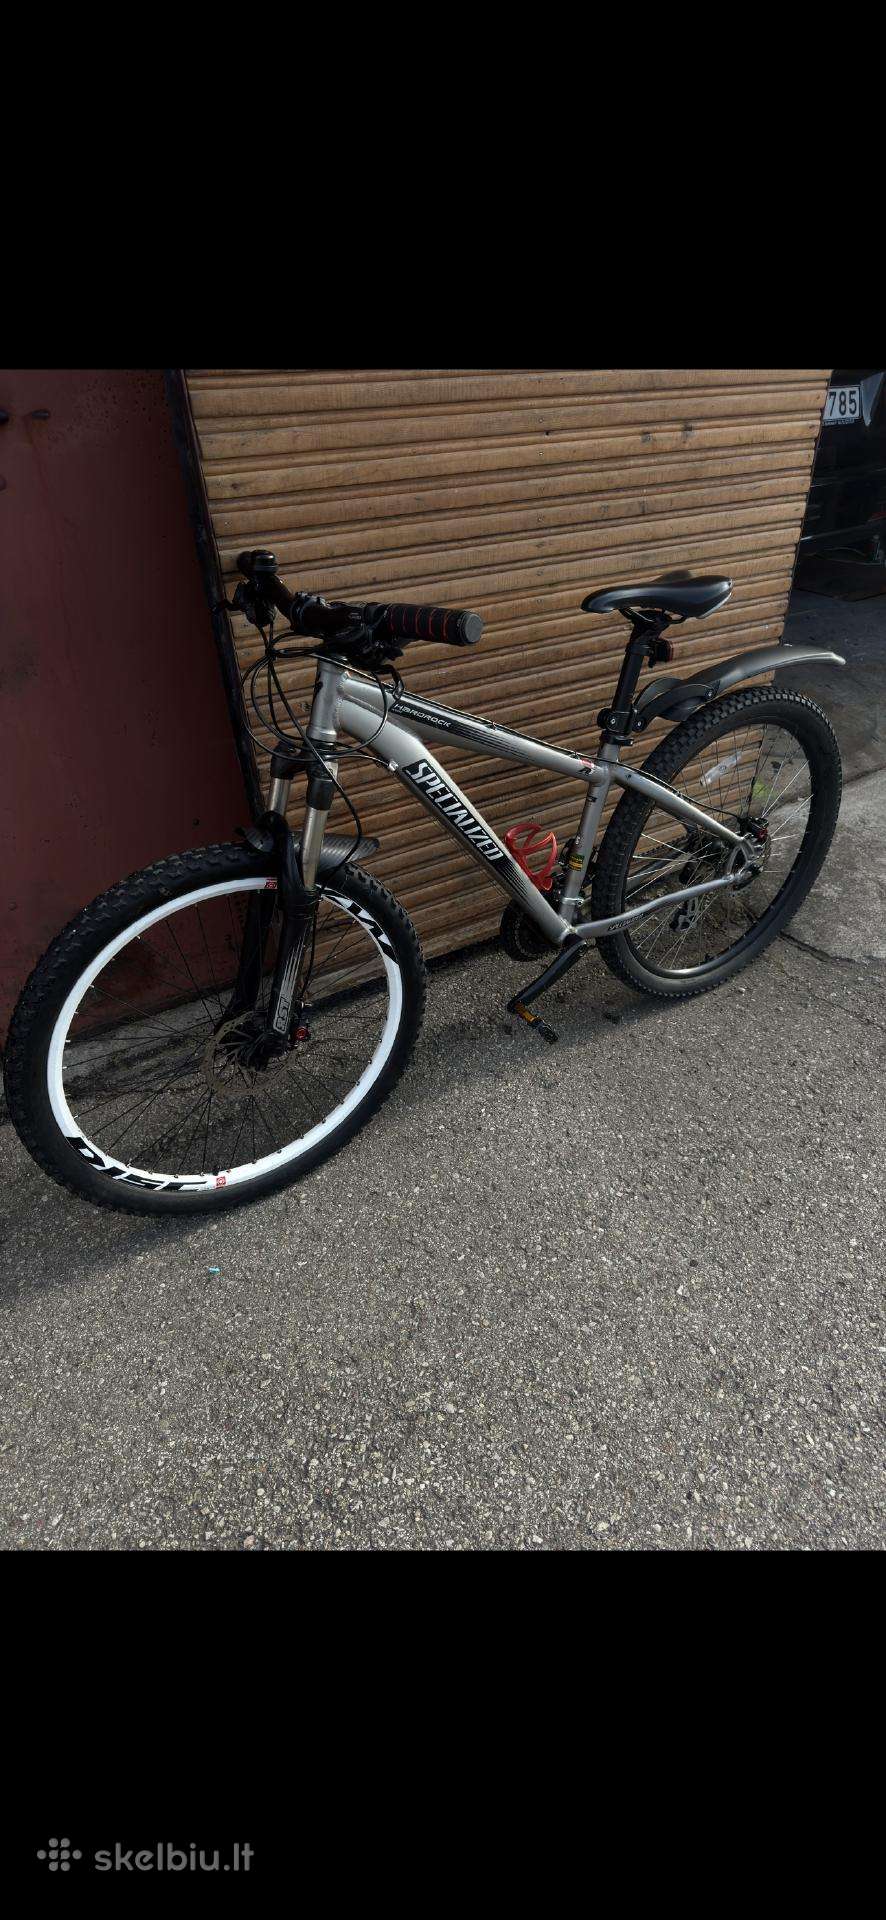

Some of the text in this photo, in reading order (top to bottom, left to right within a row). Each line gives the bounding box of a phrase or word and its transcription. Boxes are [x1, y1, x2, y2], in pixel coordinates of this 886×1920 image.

[828, 390, 857, 417] 785
[393, 703, 452, 728] HARDROCK
[406, 761, 504, 862] SPECIALIZED
[65, 1136, 208, 1191] DISC
